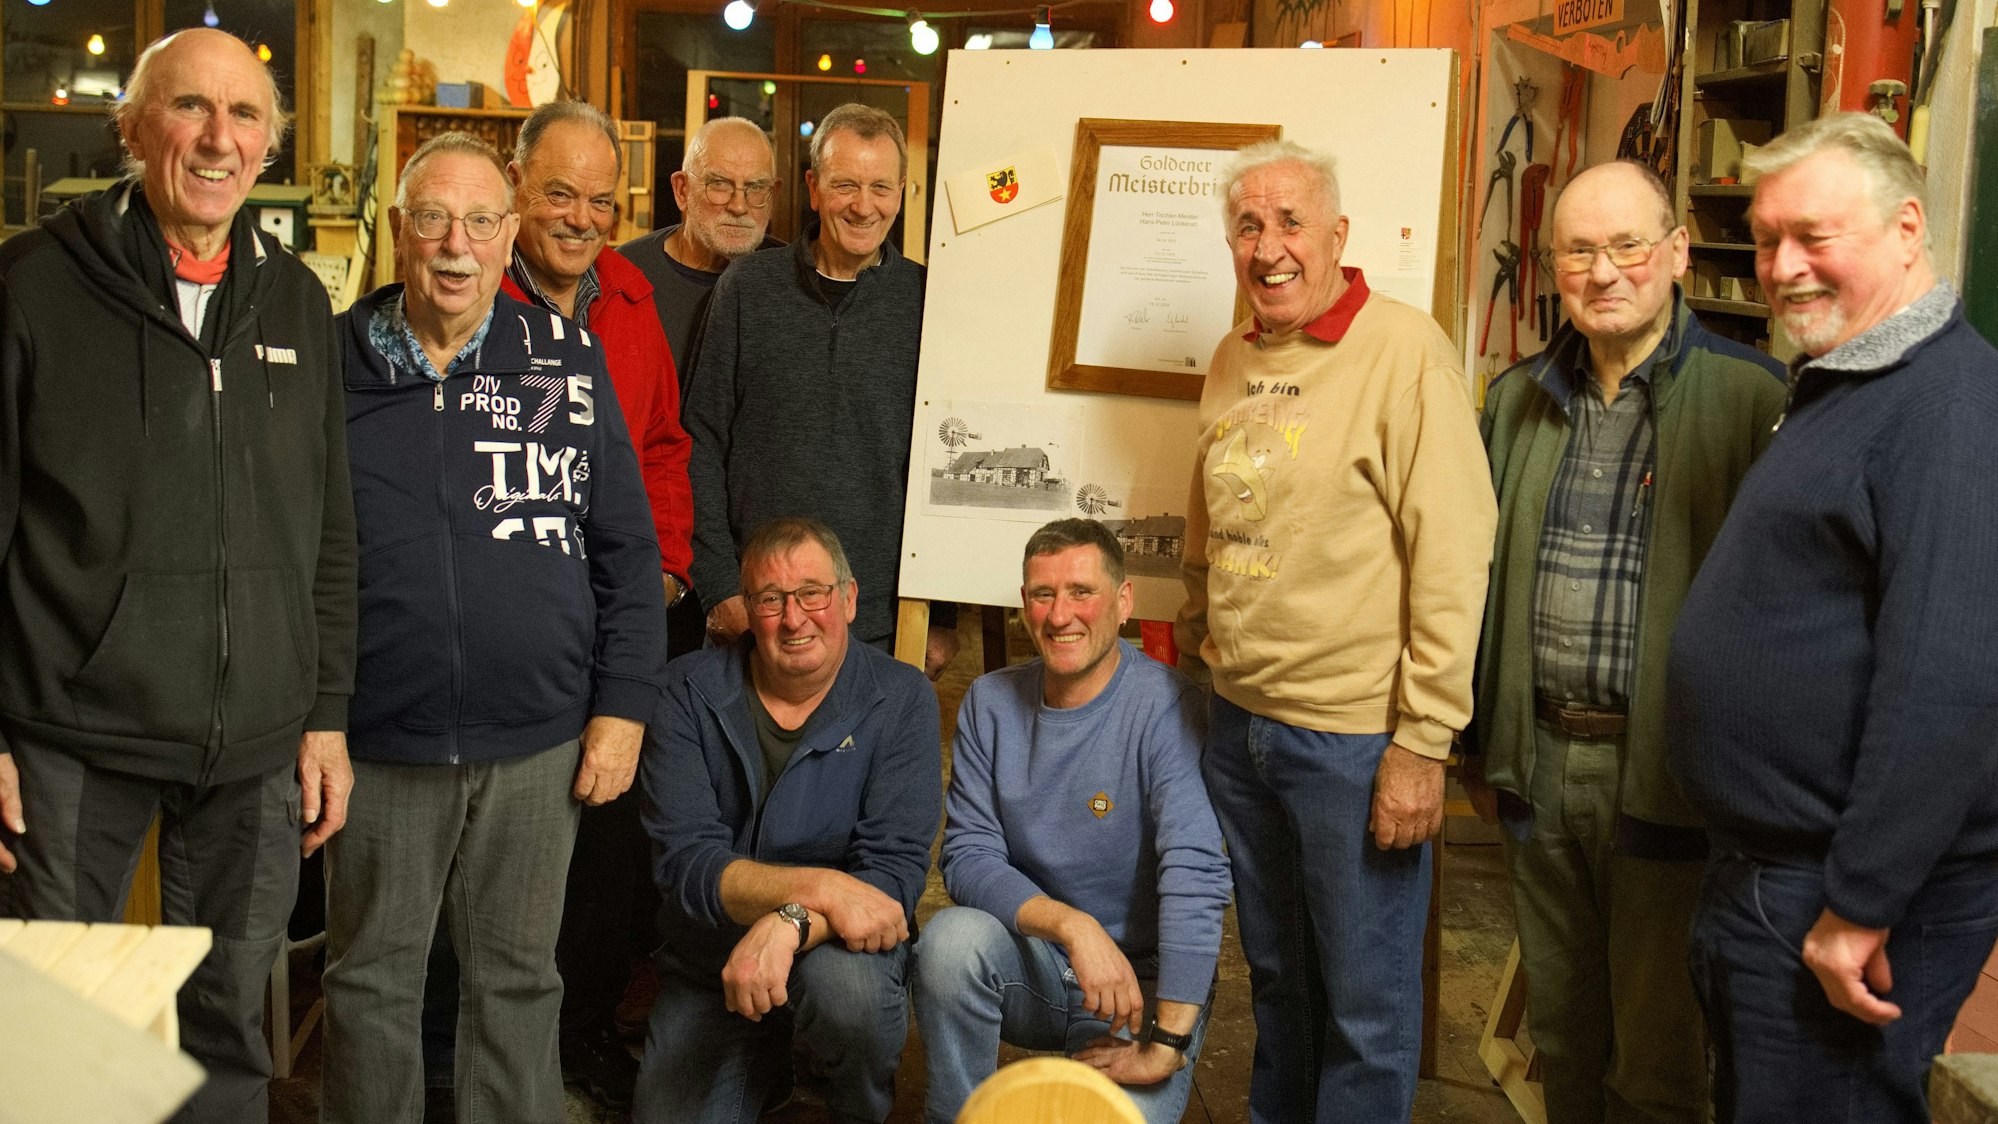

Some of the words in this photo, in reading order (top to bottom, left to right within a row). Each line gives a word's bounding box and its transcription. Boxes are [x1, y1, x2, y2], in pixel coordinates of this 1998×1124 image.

[1140, 154, 1212, 172] Goldener
[1108, 173, 1218, 196] Meisterbri
[254, 344, 298, 365] PUMA
[472, 374, 501, 395] DIY
[1247, 381, 1265, 397] Ich
[1270, 382, 1300, 396] bin
[460, 392, 521, 416] PROD
[492, 414, 523, 432] NO.
